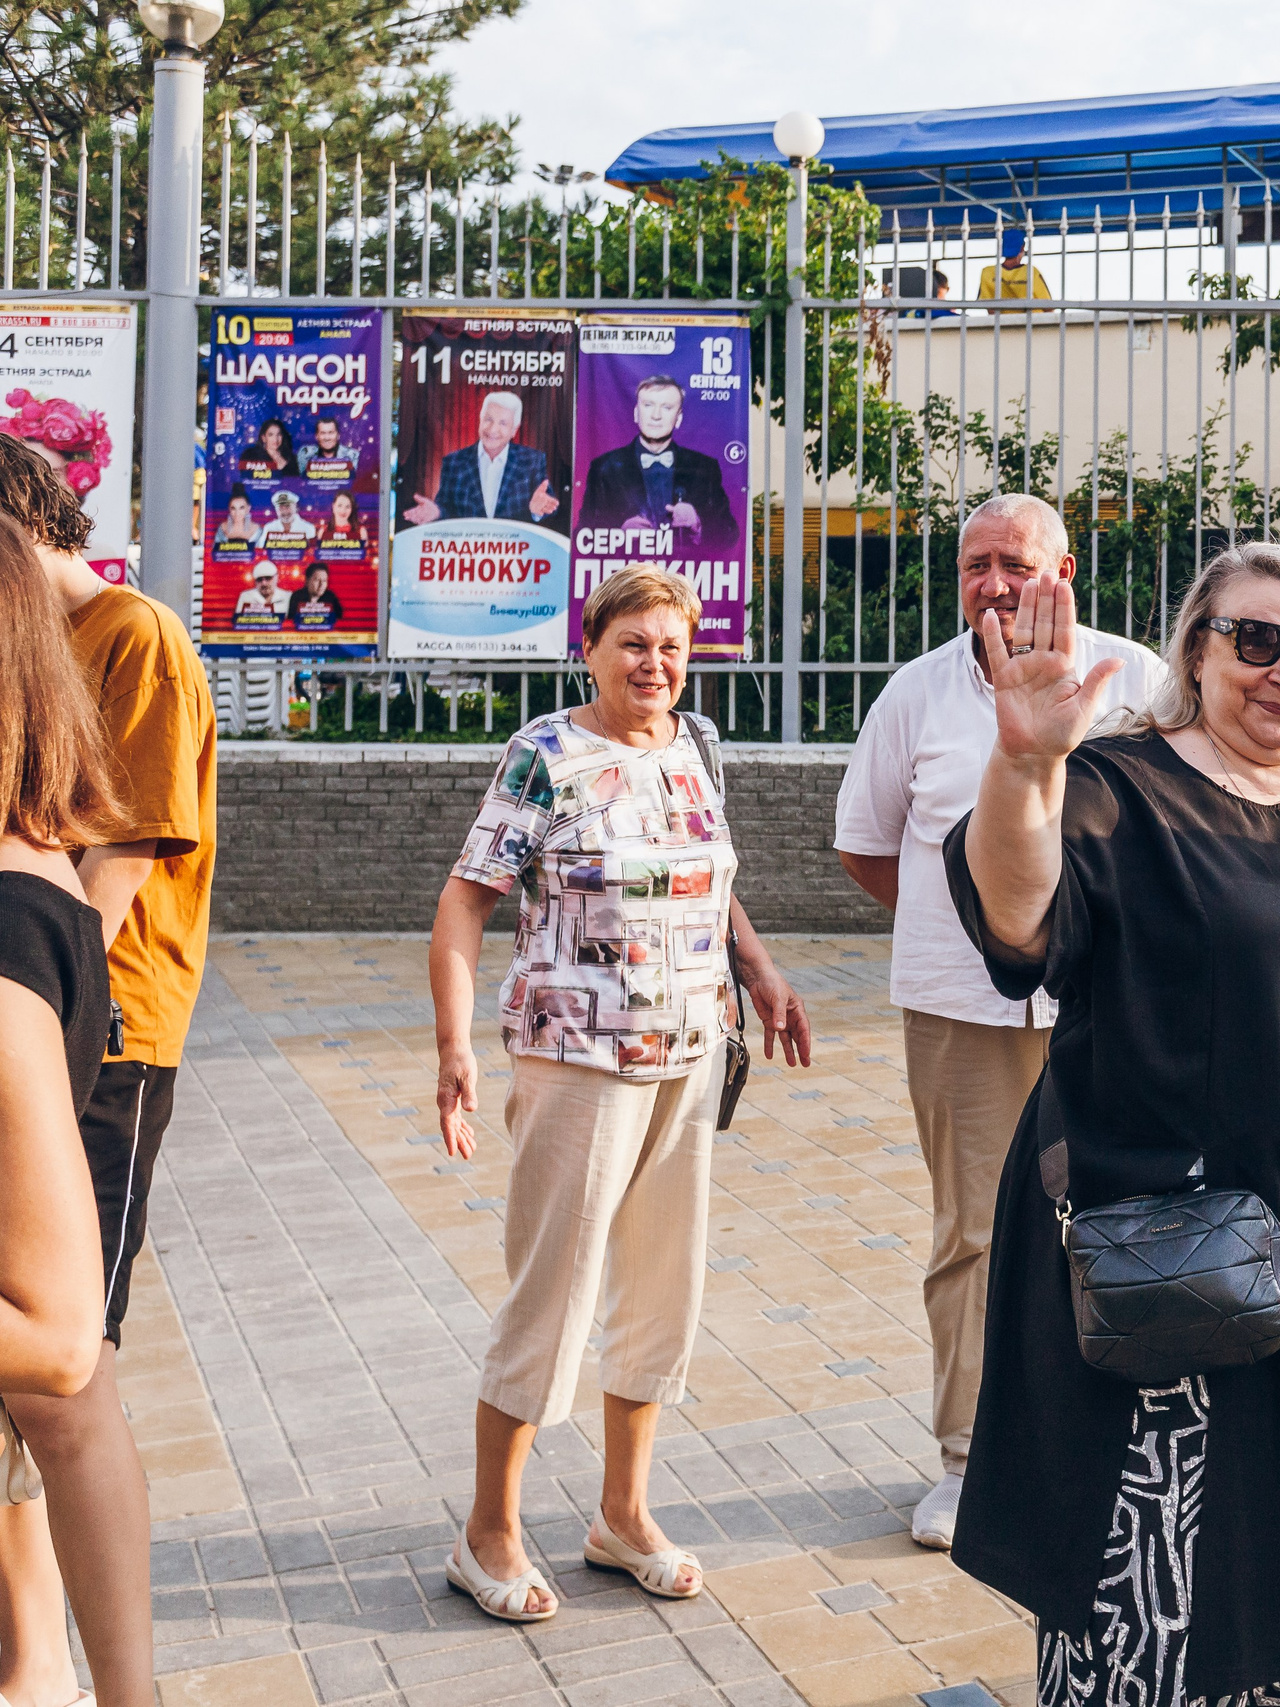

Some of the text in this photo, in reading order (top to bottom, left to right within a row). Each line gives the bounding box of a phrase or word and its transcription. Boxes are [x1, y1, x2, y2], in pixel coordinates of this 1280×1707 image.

[216, 315, 251, 345] 10
[464, 319, 573, 335] ЛЕТНЯЯ ЭСТРАДА
[258, 333, 290, 346] 20:00
[582, 329, 675, 343] ЛЕТНЯЯ ЭСТРАДА
[0, 333, 104, 360] 4 СЕНТЯБРЯ
[700, 336, 733, 375] 13
[39, 368, 92, 378] ЭСТРАДА
[216, 353, 367, 384] ШАНСОН
[410, 346, 566, 385] 11 СЕНТЯБРЯ
[467, 374, 563, 388] НАЧАЛО В 20:00
[689, 373, 741, 390] СЕНТЯБРЯ
[276, 385, 372, 420] парад
[700, 390, 731, 401] 20:00
[729, 444, 745, 460] 6+
[576, 522, 674, 556] СЕРГЕЙ
[421, 540, 530, 557] ВЛАДИМИР
[418, 557, 552, 584] ВИНОКУР
[573, 558, 740, 601] ПИН
[416, 642, 453, 651] КАССА
[501, 642, 538, 653] 3-94-36
